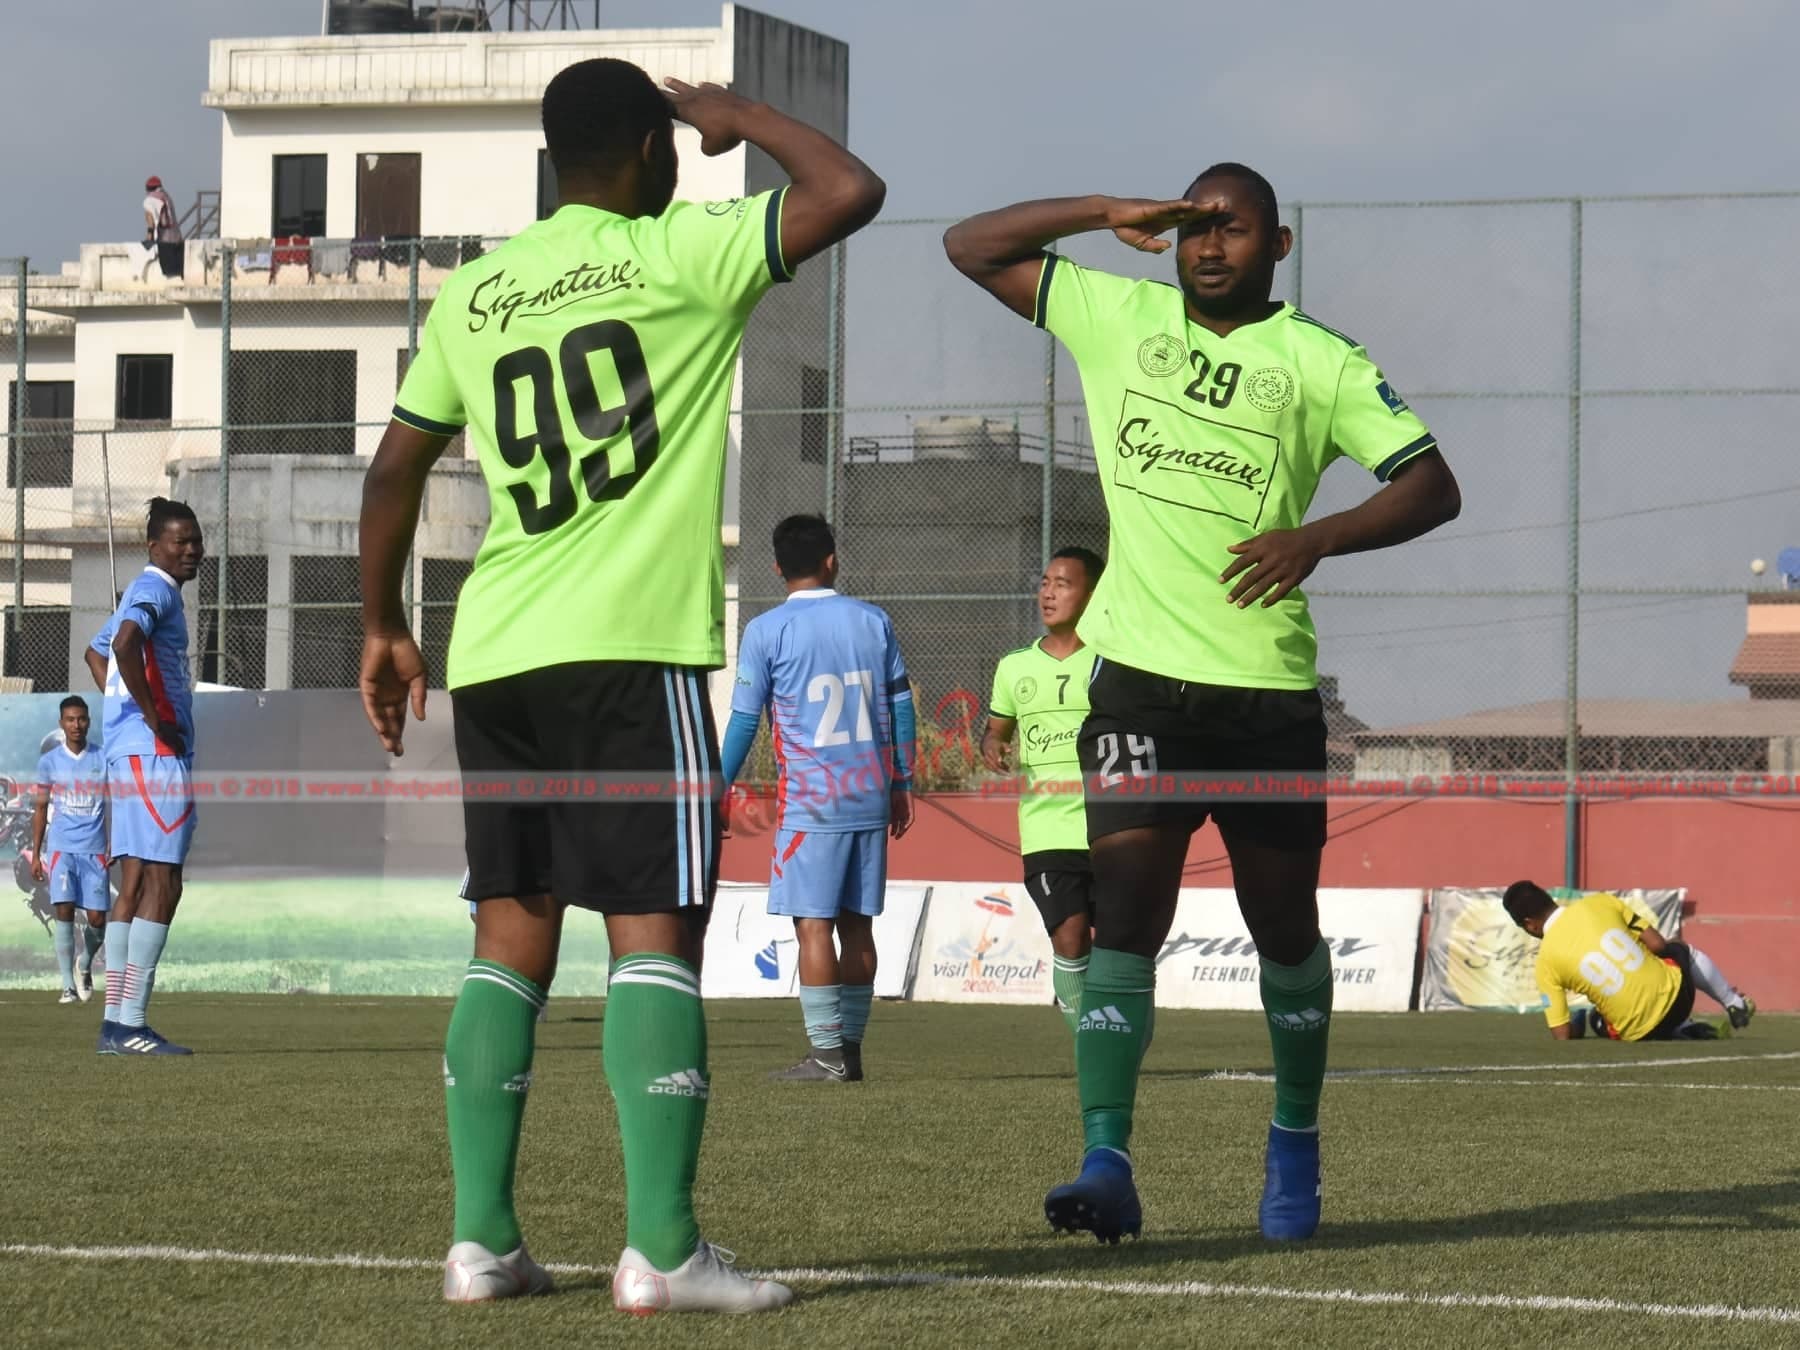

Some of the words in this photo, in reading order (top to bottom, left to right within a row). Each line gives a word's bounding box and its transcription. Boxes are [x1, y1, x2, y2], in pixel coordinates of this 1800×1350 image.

[1184, 349, 1243, 409] 29
[493, 319, 660, 535] 99
[1055, 674, 1071, 705] 7
[807, 670, 873, 748] 27
[1027, 724, 1081, 753] Signa
[1097, 732, 1158, 788] 29
[933, 961, 969, 977] visit
[982, 958, 1042, 986] nepal
[1191, 966, 1258, 982] TECHNOL
[1332, 967, 1377, 984] OWER
[1579, 928, 1645, 996] 99
[961, 979, 996, 993] 2020
[647, 1081, 708, 1099] adida
